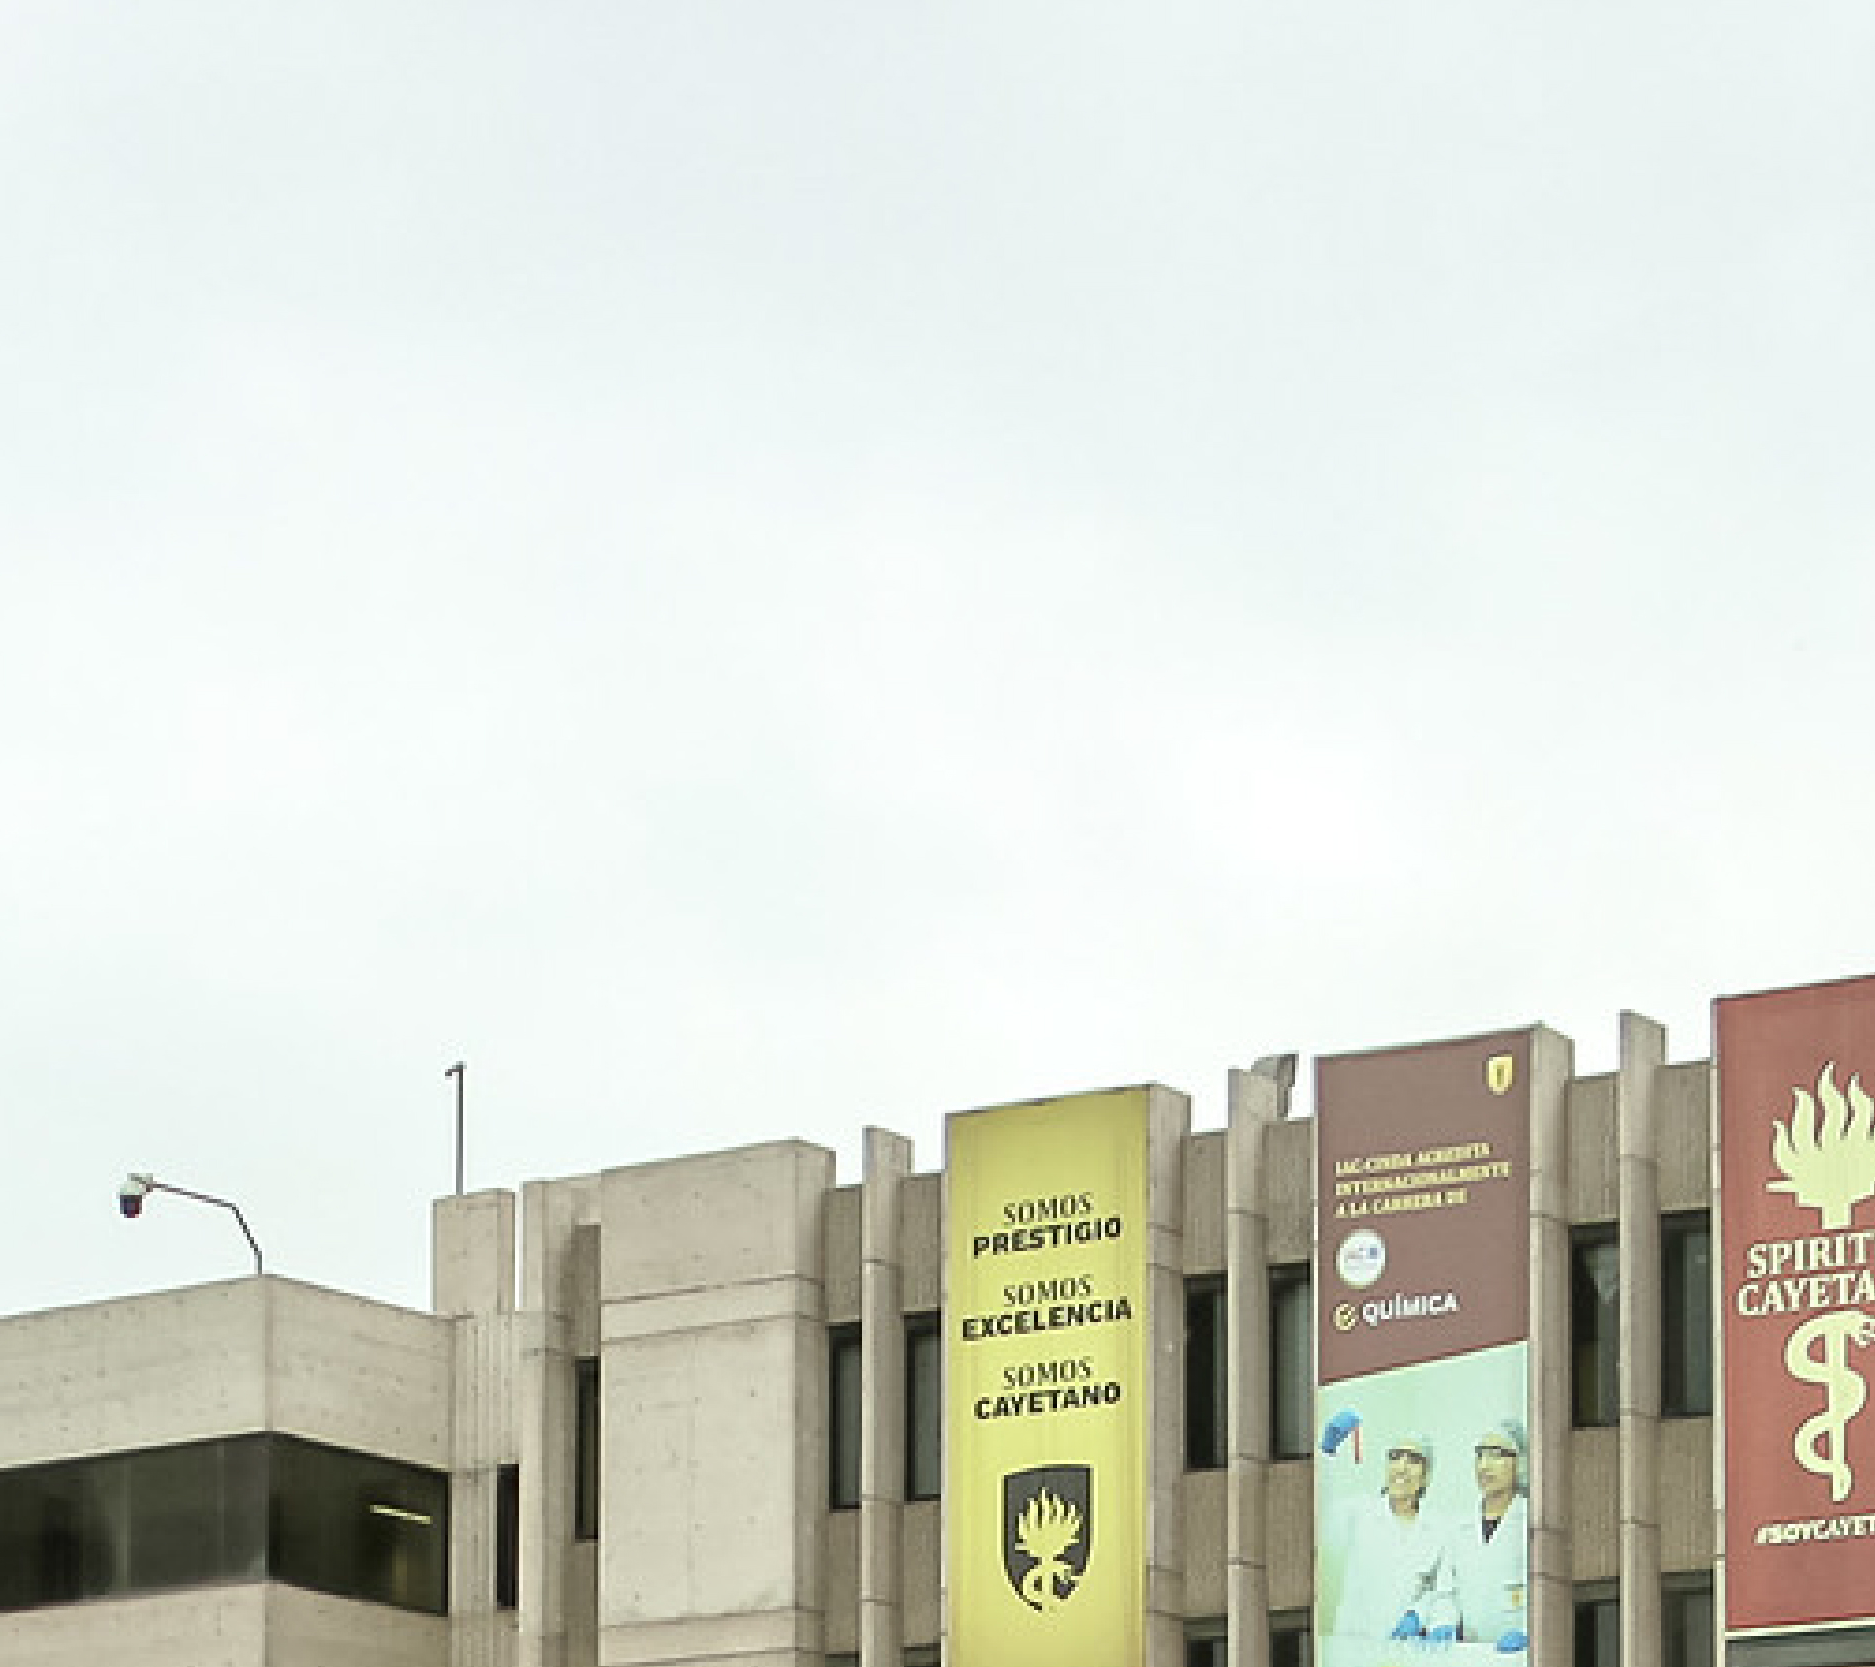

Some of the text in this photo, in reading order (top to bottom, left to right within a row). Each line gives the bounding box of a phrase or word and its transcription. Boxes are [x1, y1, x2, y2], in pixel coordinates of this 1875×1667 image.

[1002, 1191, 1093, 1225] SOMOS
[972, 1215, 1123, 1259] PRESTIGIO
[1002, 1272, 1094, 1308] SOMOS
[961, 1296, 1133, 1342] EXCELENCIA
[1002, 1355, 1094, 1391] SOMOS
[973, 1381, 1123, 1422] CAYETANO
